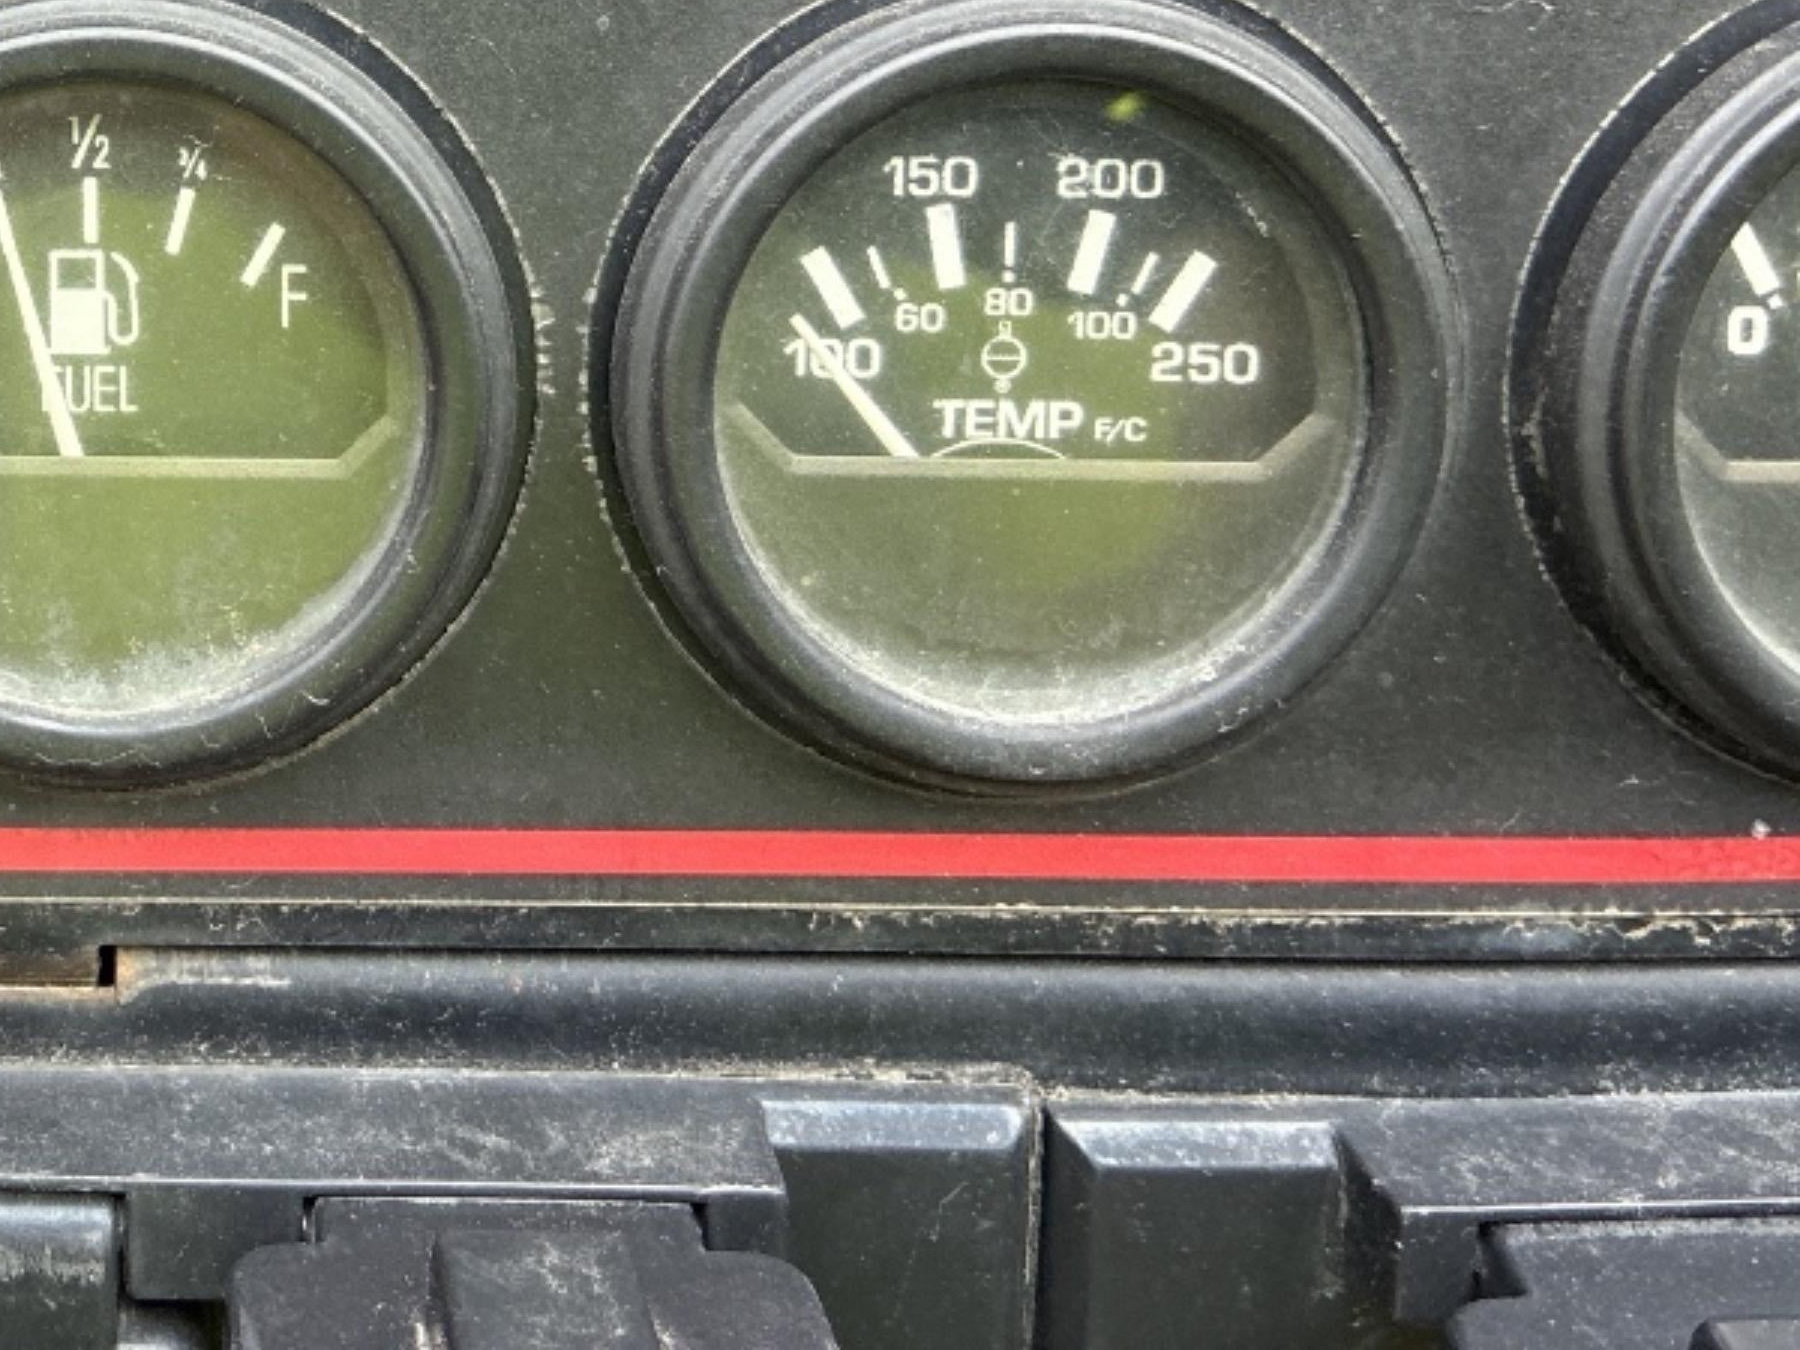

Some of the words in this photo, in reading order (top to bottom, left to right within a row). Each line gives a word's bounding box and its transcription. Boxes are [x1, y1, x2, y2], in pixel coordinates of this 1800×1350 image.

[884, 156, 979, 198] 150
[1057, 158, 1165, 199] 200
[281, 264, 308, 328] F
[984, 288, 1033, 316] 80
[895, 302, 945, 333] 60
[1068, 311, 1138, 340] 100
[1727, 306, 1770, 355] 0
[783, 336, 882, 379] 100
[1150, 343, 1260, 384] 250
[932, 398, 1084, 439] TEMP
[1094, 416, 1148, 446] F/C
